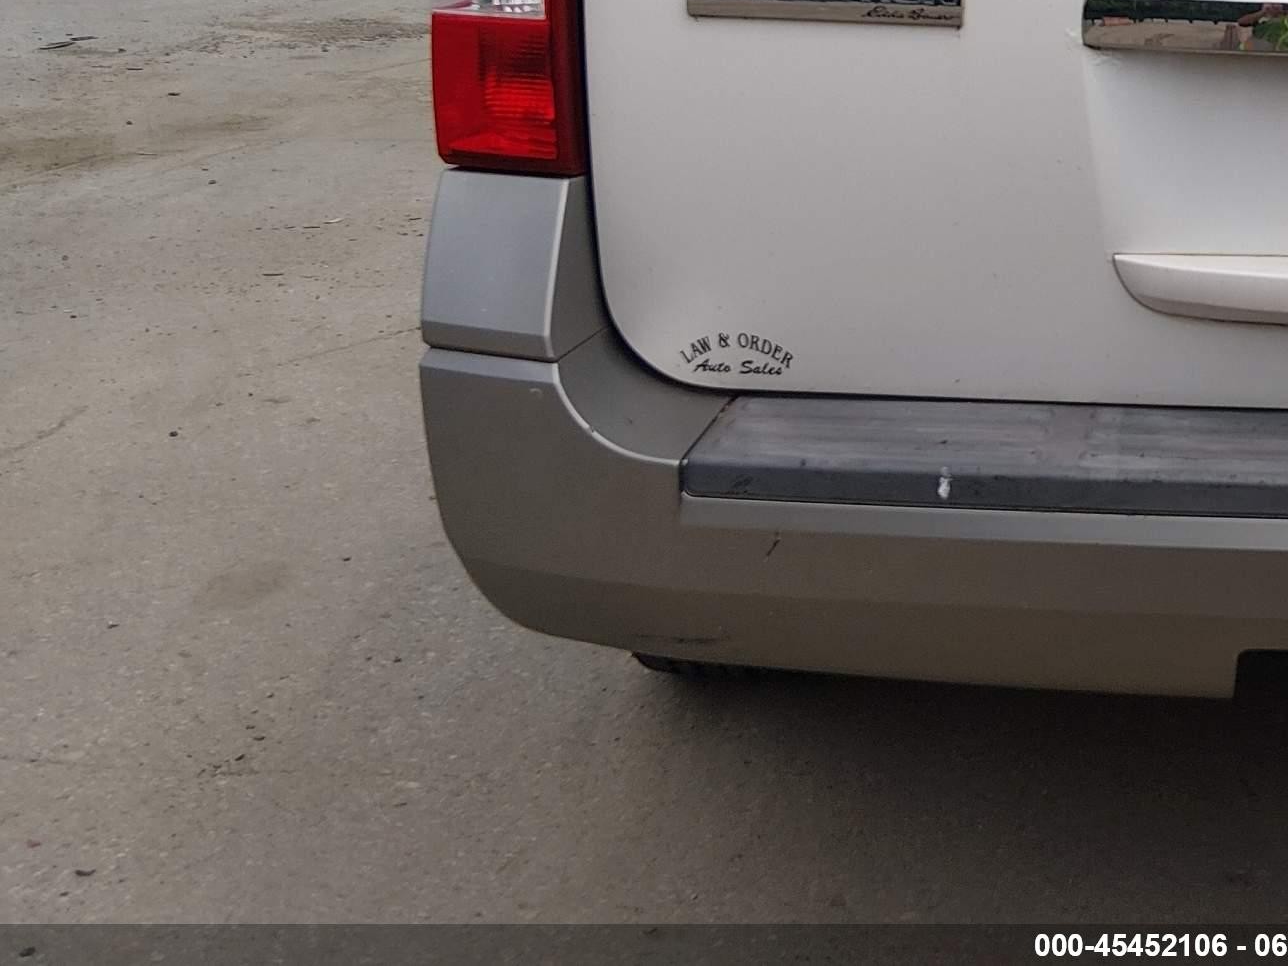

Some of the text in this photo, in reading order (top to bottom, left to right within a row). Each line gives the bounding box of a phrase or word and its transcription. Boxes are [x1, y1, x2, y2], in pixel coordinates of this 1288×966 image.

[680, 332, 794, 369] LAW & ORDER
[693, 358, 782, 375] Auto Sales
